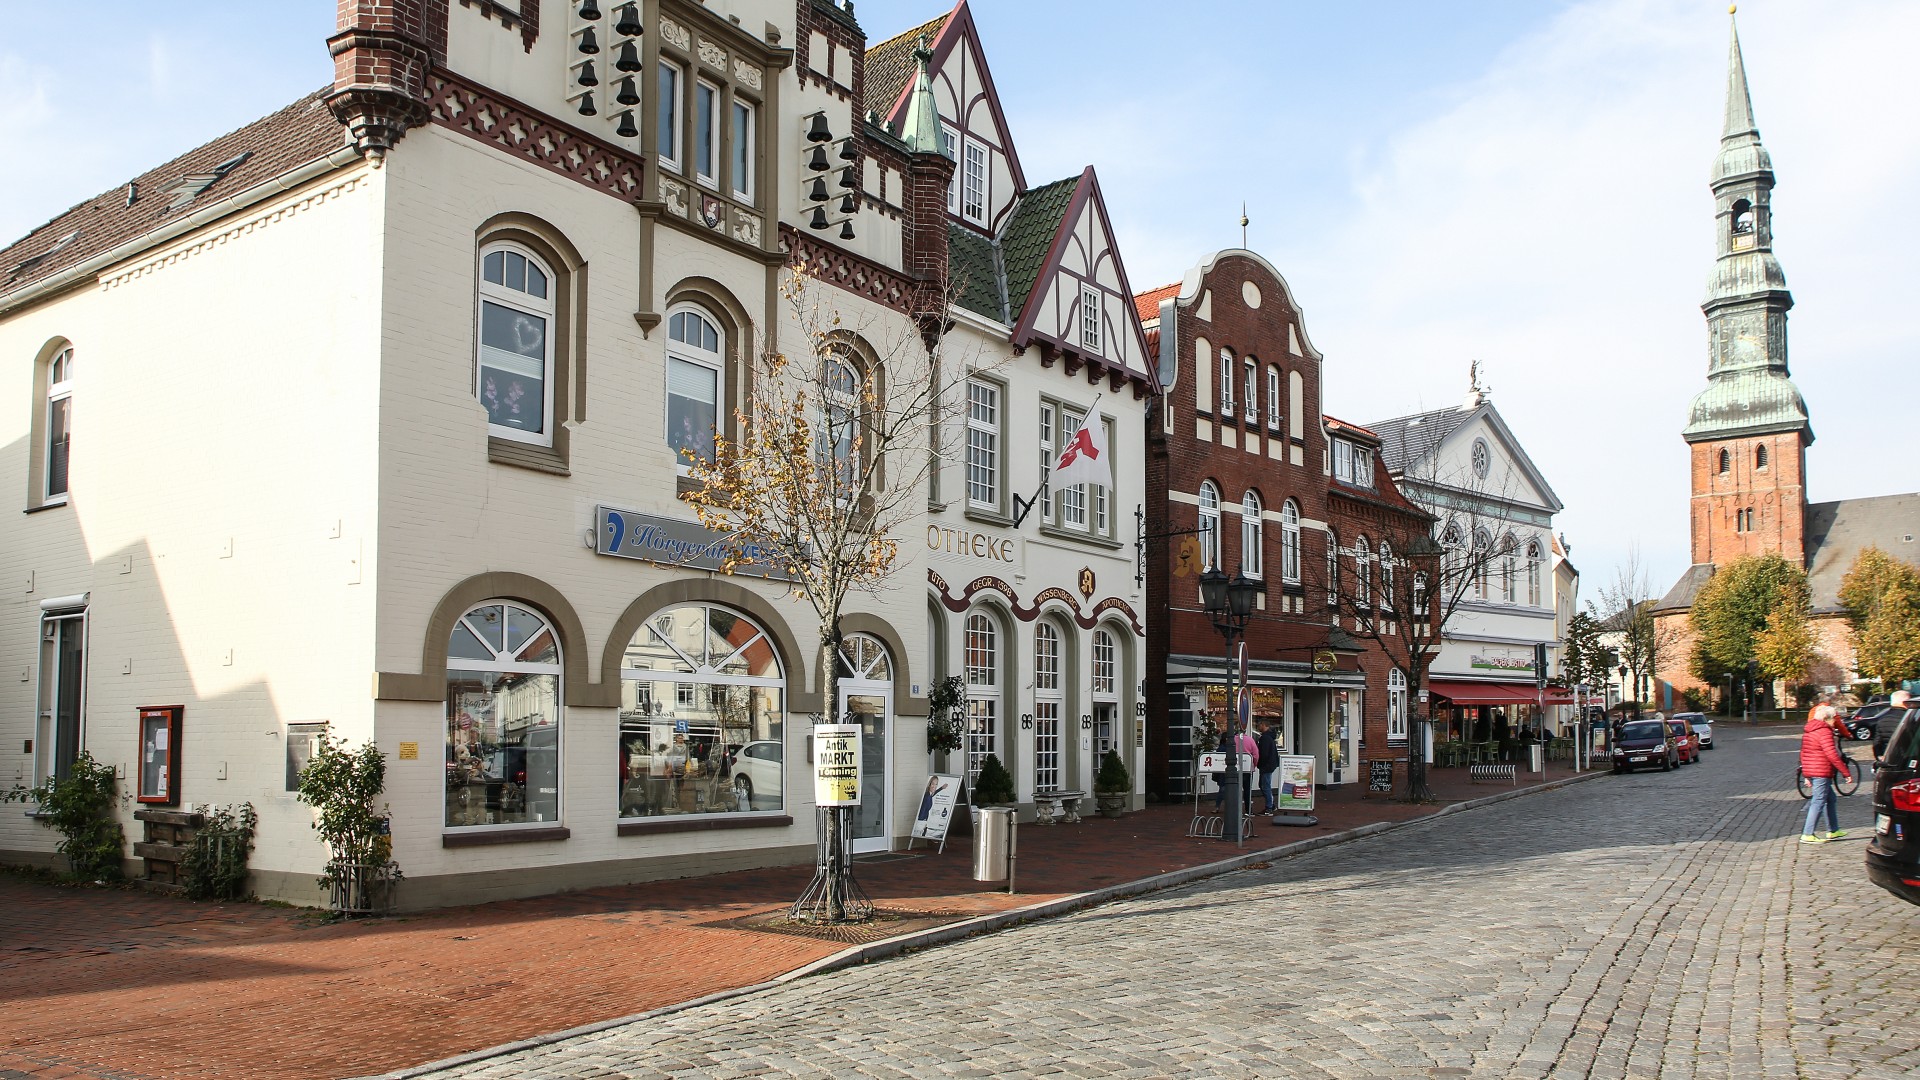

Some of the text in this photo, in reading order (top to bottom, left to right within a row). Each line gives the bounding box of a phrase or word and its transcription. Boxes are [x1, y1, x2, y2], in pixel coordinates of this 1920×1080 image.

[997, 581, 1012, 597] 1598
[1037, 589, 1077, 609] WASSENBERG
[1102, 599, 1130, 614] APOTHEKE
[826, 739, 848, 751] Antik
[820, 752, 855, 765] MARKT
[819, 767, 857, 777] Tönning
